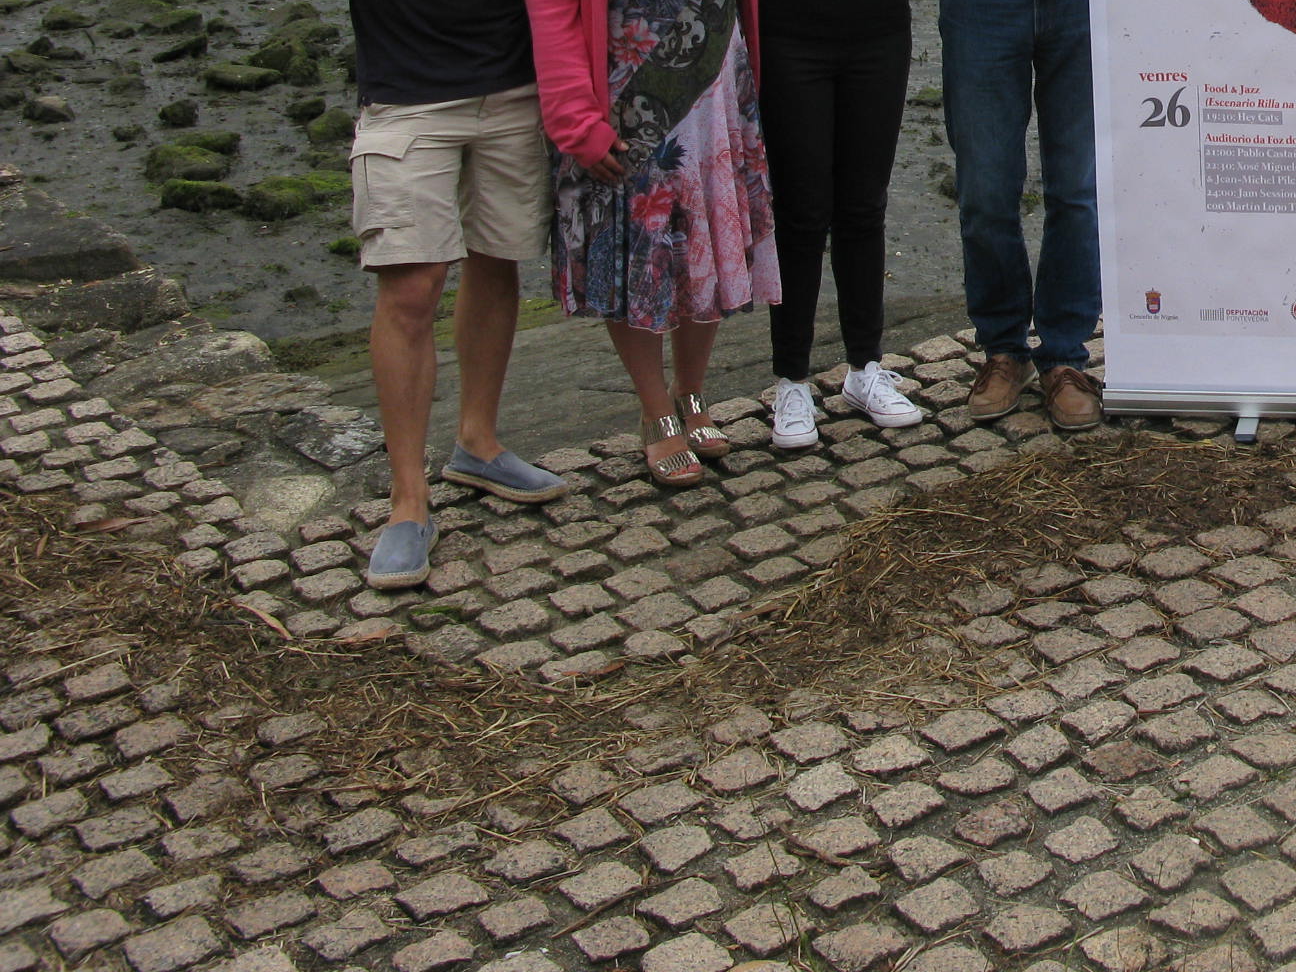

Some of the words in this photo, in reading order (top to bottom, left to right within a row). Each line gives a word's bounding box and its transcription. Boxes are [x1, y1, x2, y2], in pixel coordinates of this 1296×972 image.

[1139, 72, 1188, 82] venres
[1204, 84, 1227, 92] Food
[1239, 85, 1260, 95] Jazz
[1139, 86, 1191, 128] 26
[1206, 97, 1255, 107] (Escenario
[1258, 99, 1279, 108] Rilla
[1238, 113, 1255, 123] Hey
[1258, 114, 1279, 122] Cats
[1205, 133, 1251, 143] Auditorio
[1253, 135, 1265, 144] da
[1268, 135, 1284, 144] Foz
[1238, 149, 1264, 157] Pablo
[1260, 189, 1296, 198] Session
